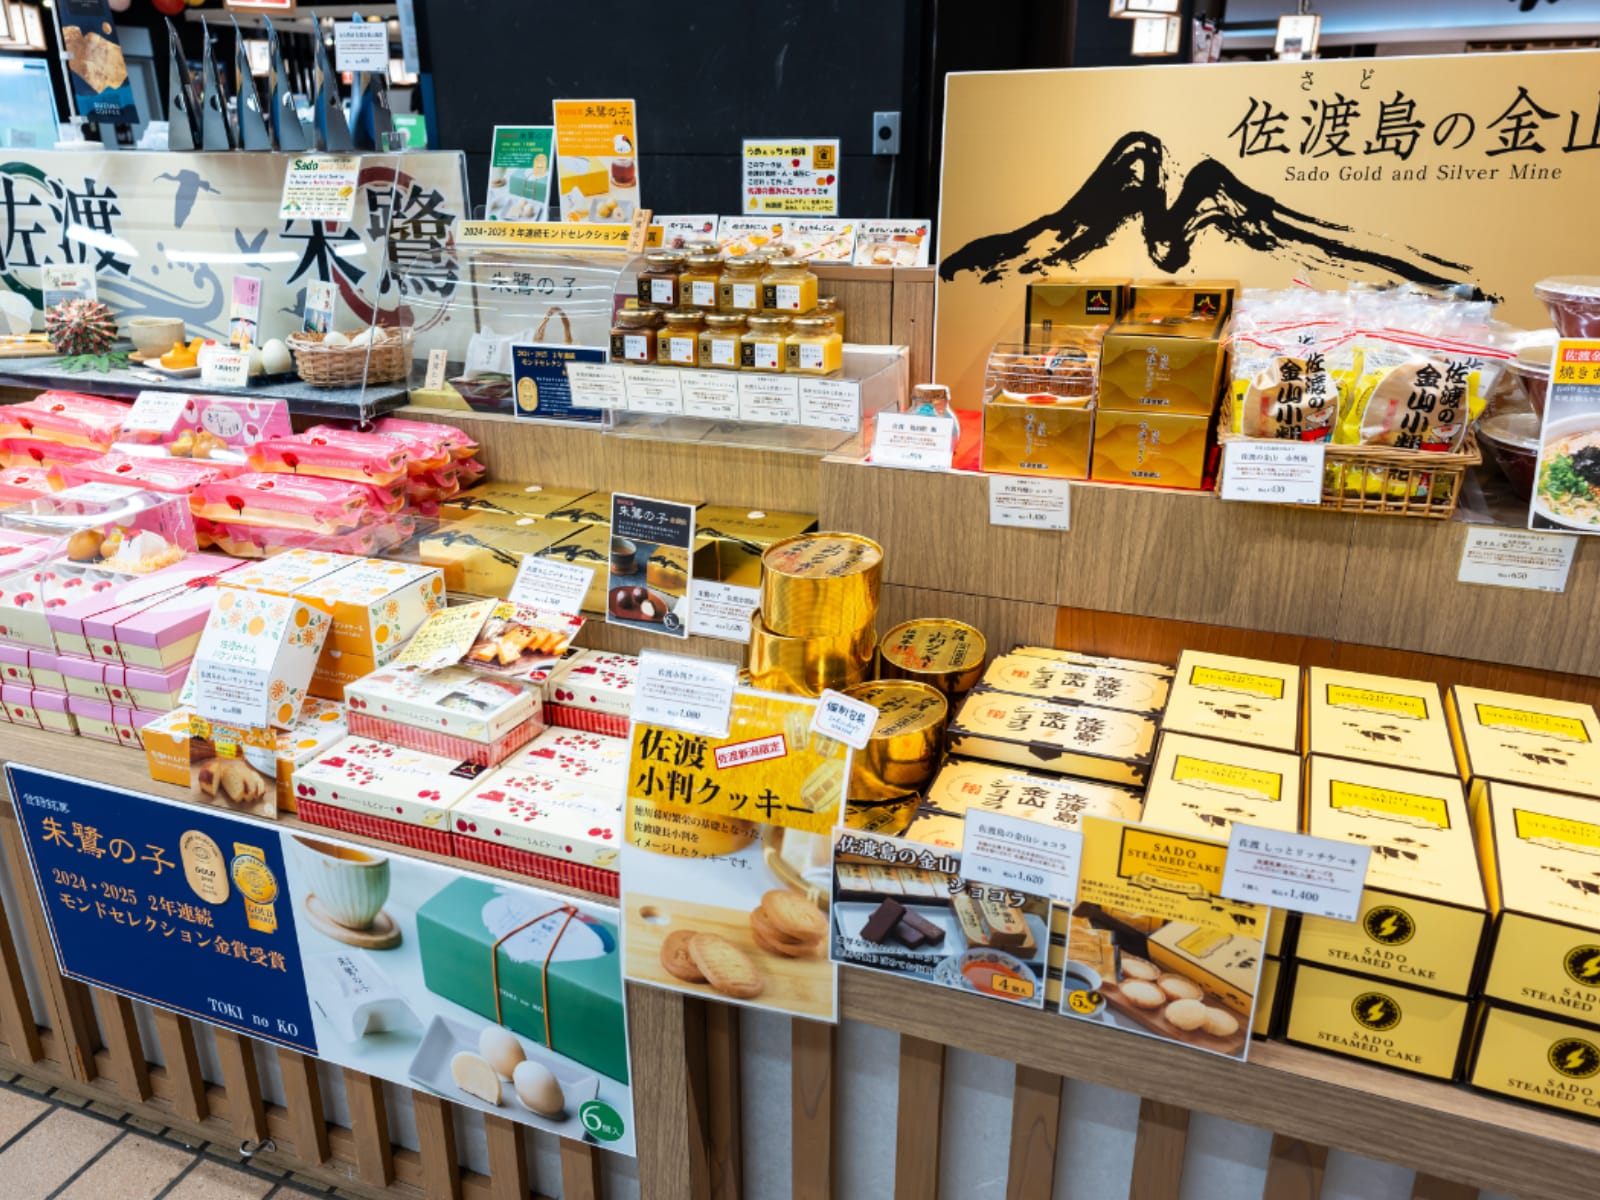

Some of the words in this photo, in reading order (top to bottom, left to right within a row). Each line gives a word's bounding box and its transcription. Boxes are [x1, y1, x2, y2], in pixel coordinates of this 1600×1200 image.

[294, 159, 318, 171] Sado
[1285, 166, 1330, 182] Sado
[1339, 165, 1383, 181] Gold
[1392, 164, 1427, 181] and
[1436, 164, 1500, 180] Silver
[1509, 164, 1562, 180] Mine
[0, 177, 132, 278] 佐渡
[509, 226, 657, 242] 2年連続モンドセレクション金賞
[618, 505, 669, 524] 朱鷺の子
[640, 728, 708, 770] 佐渡
[718, 742, 781, 763] 佐渡新潟限定
[636, 766, 815, 819] 小判クッキー
[633, 821, 699, 842] 佐渡慶長小判を
[978, 824, 1067, 850] 佐渡島の金山ショコラ
[1240, 838, 1260, 849] 佐渡
[41, 816, 176, 875] 朱鷺の子
[634, 838, 753, 870] イメージしたクッキーです。
[838, 834, 961, 875] 佐渡島の金山
[1154, 843, 1197, 859] SADO
[1127, 849, 1185, 866] STEAMED
[1188, 861, 1221, 874] CAKE
[52, 868, 138, 905] 2024・2025
[148, 895, 215, 929] 2年連続
[948, 876, 1026, 908] ショコラ
[59, 891, 288, 972] モンドセレクション金賞受賞
[1328, 948, 1391, 970] STEAMED
[1398, 964, 1437, 980] CAKE
[1364, 946, 1408, 964] SADO
[1521, 986, 1593, 1012] STEAMED
[1563, 987, 1600, 1005] SAD
[207, 997, 244, 1021] TOKI
[252, 1013, 270, 1028] no
[278, 1018, 299, 1038] KO
[1317, 1031, 1378, 1053] STEAMED
[1385, 1048, 1423, 1065] CAKE
[1352, 1030, 1395, 1049] SADO
[1507, 1077, 1576, 1102] STEAMED
[1583, 1096, 1600, 1111] CA
[1546, 1079, 1594, 1097] SADO
